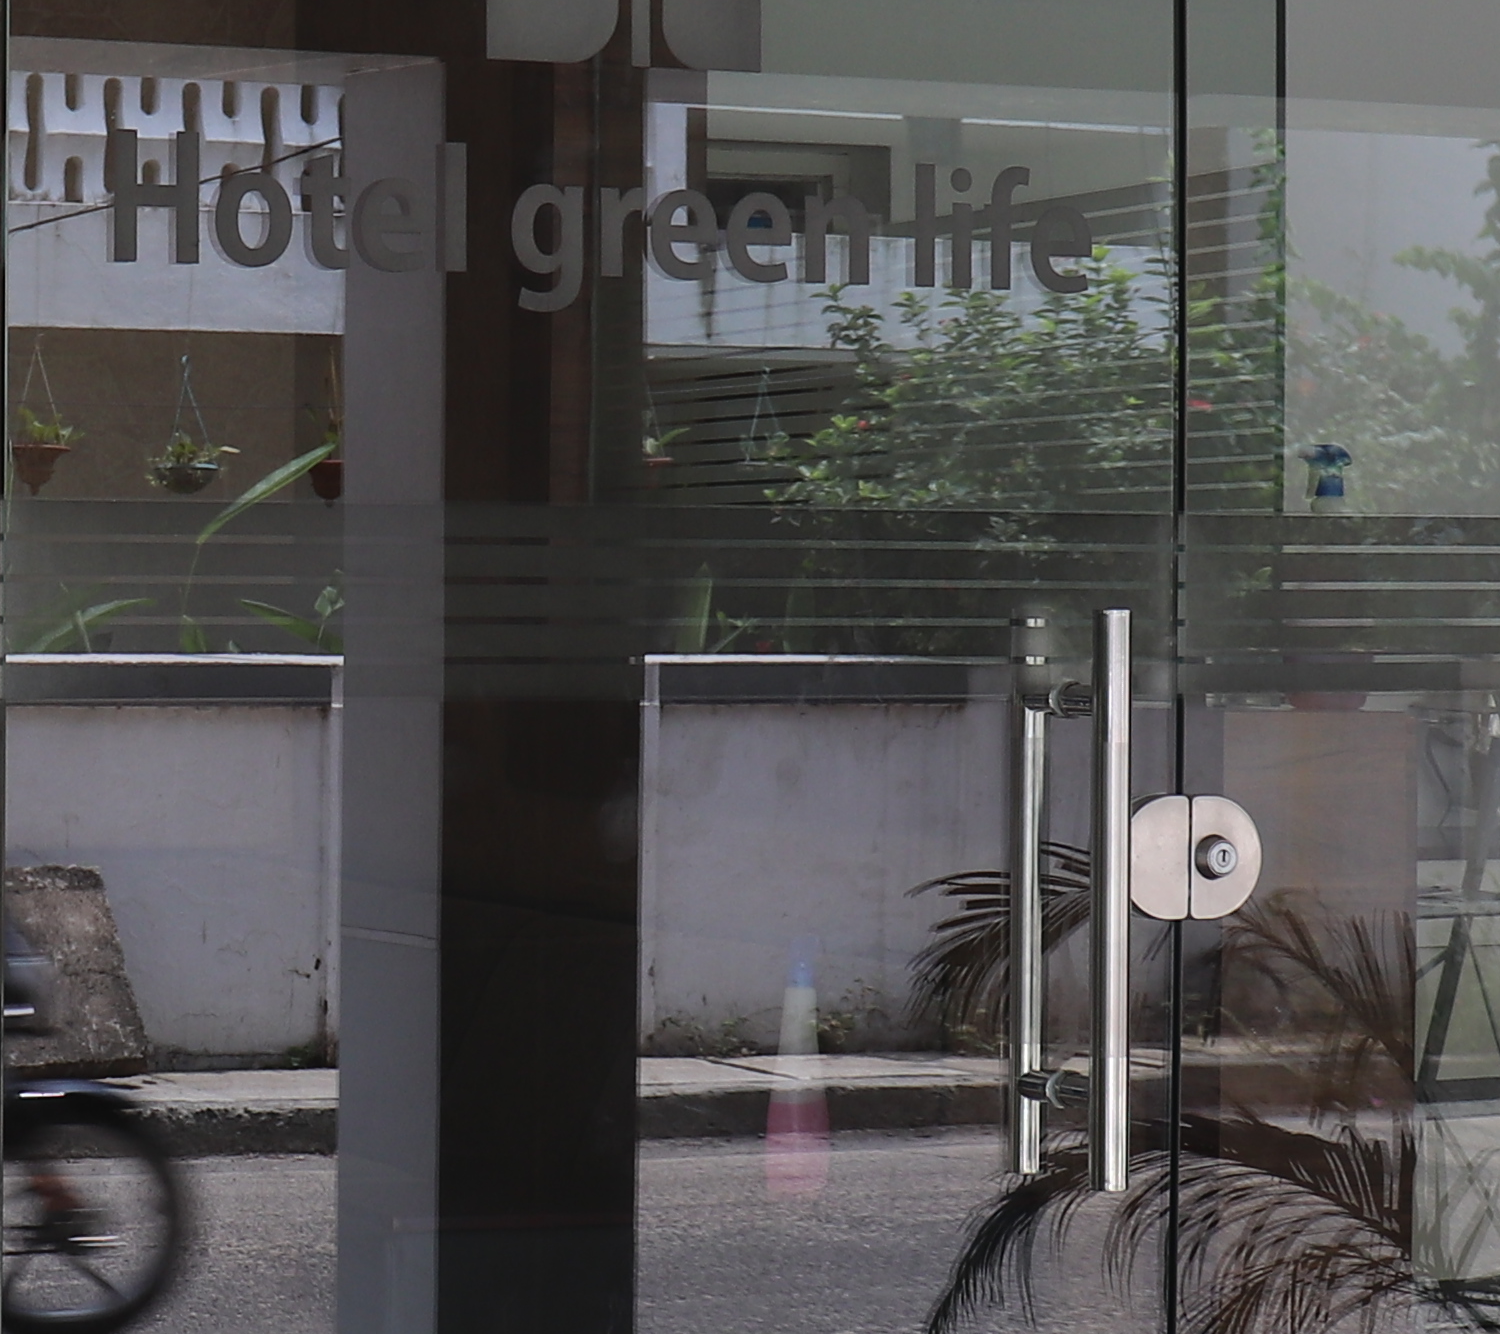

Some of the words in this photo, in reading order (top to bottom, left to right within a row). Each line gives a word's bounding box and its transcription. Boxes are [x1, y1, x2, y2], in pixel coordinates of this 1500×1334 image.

[109, 128, 468, 274] Hotel
[510, 182, 870, 313] green
[912, 162, 1093, 295] life
